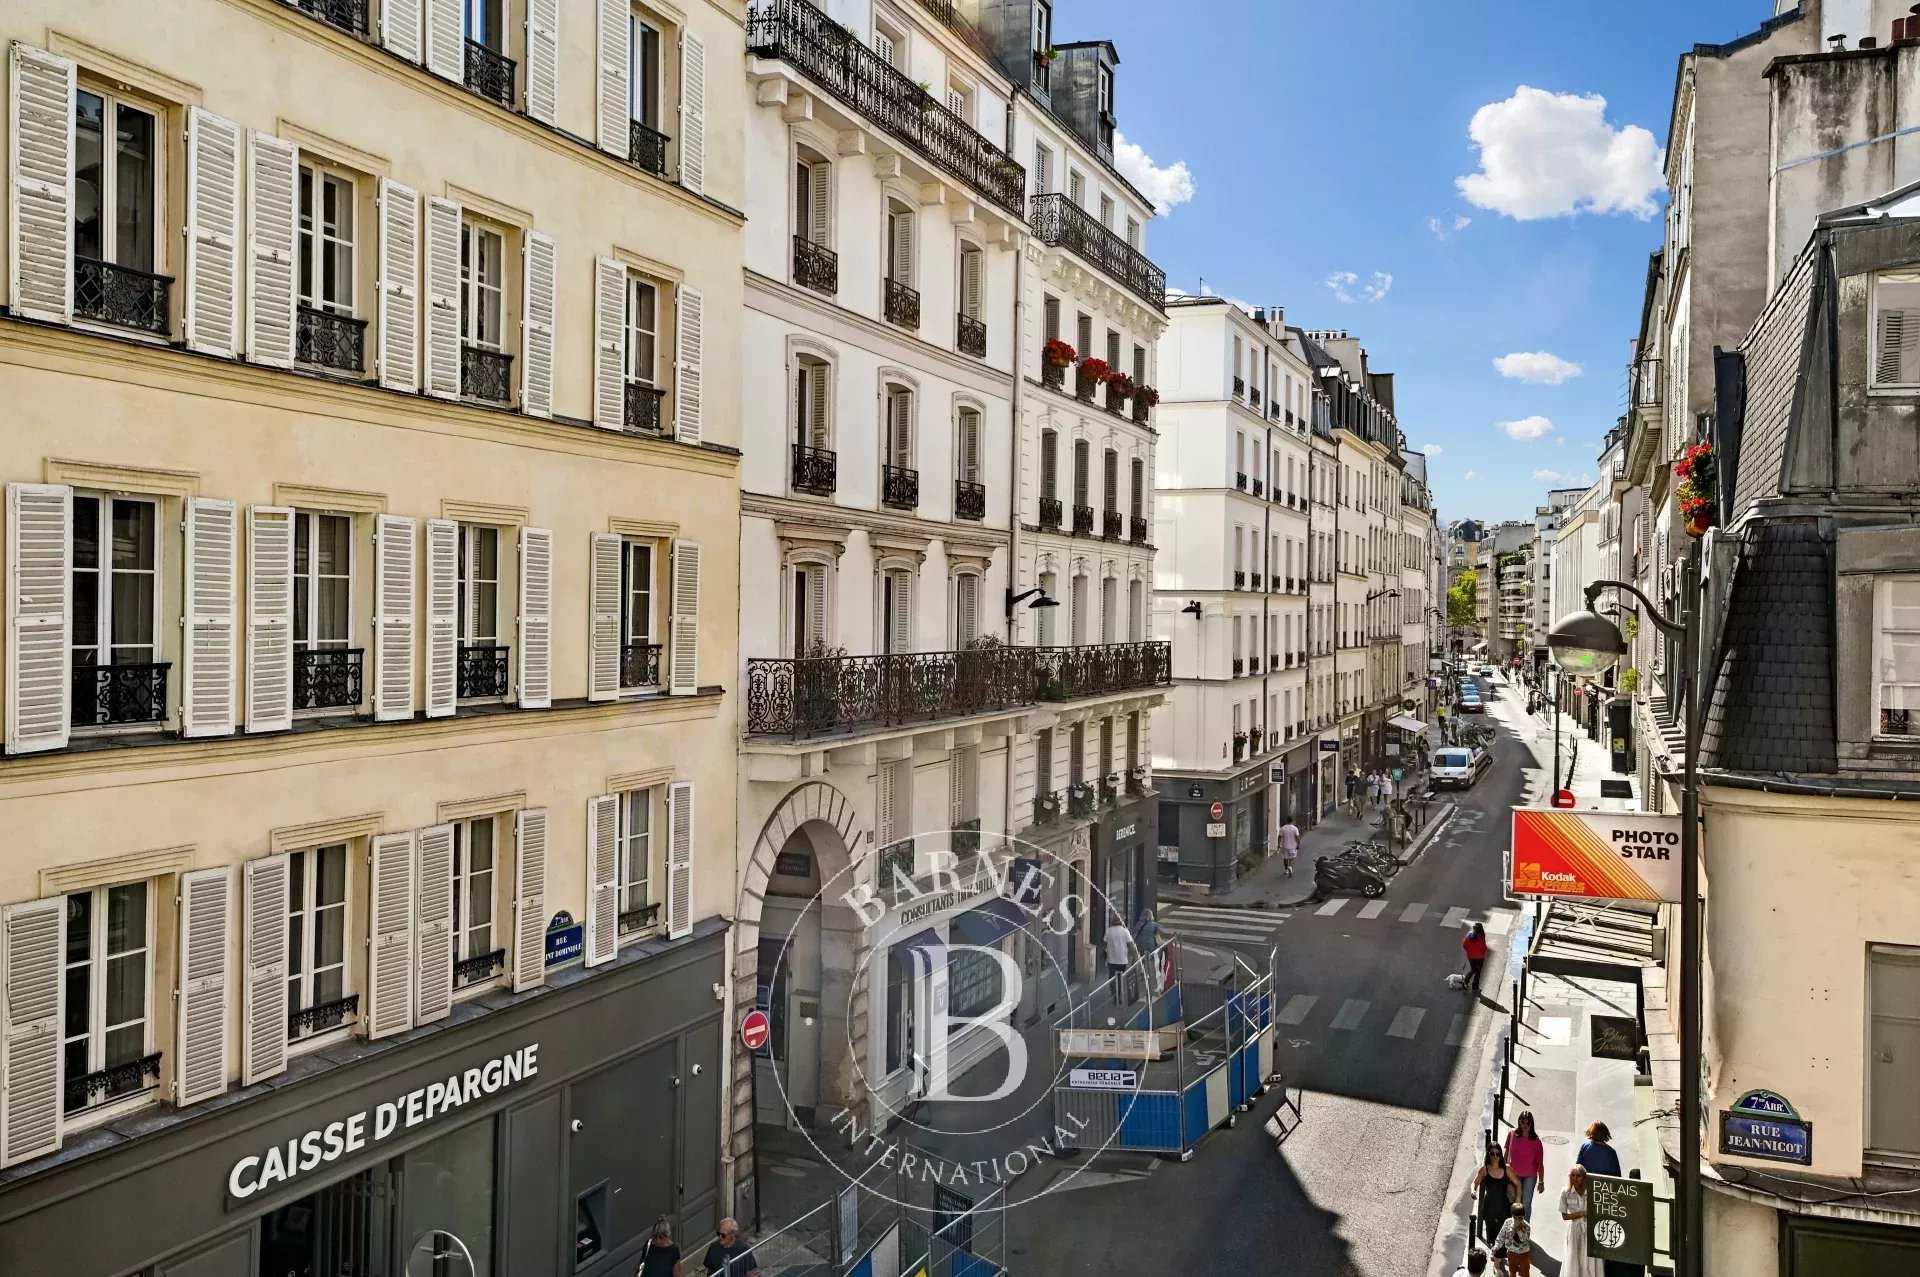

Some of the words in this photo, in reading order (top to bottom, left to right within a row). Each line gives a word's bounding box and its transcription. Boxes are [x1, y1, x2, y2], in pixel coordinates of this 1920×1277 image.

[1612, 829, 1679, 846] PHOTO
[1621, 845, 1670, 860] STAR
[1541, 871, 1577, 882] Kodak
[228, 1111, 367, 1198] CAISSE
[374, 1043, 539, 1141] D'EPARGNE
[1751, 1124, 1781, 1138] RUE
[1593, 1180, 1639, 1197] PALAIS
[1593, 1191, 1619, 1206] DES
